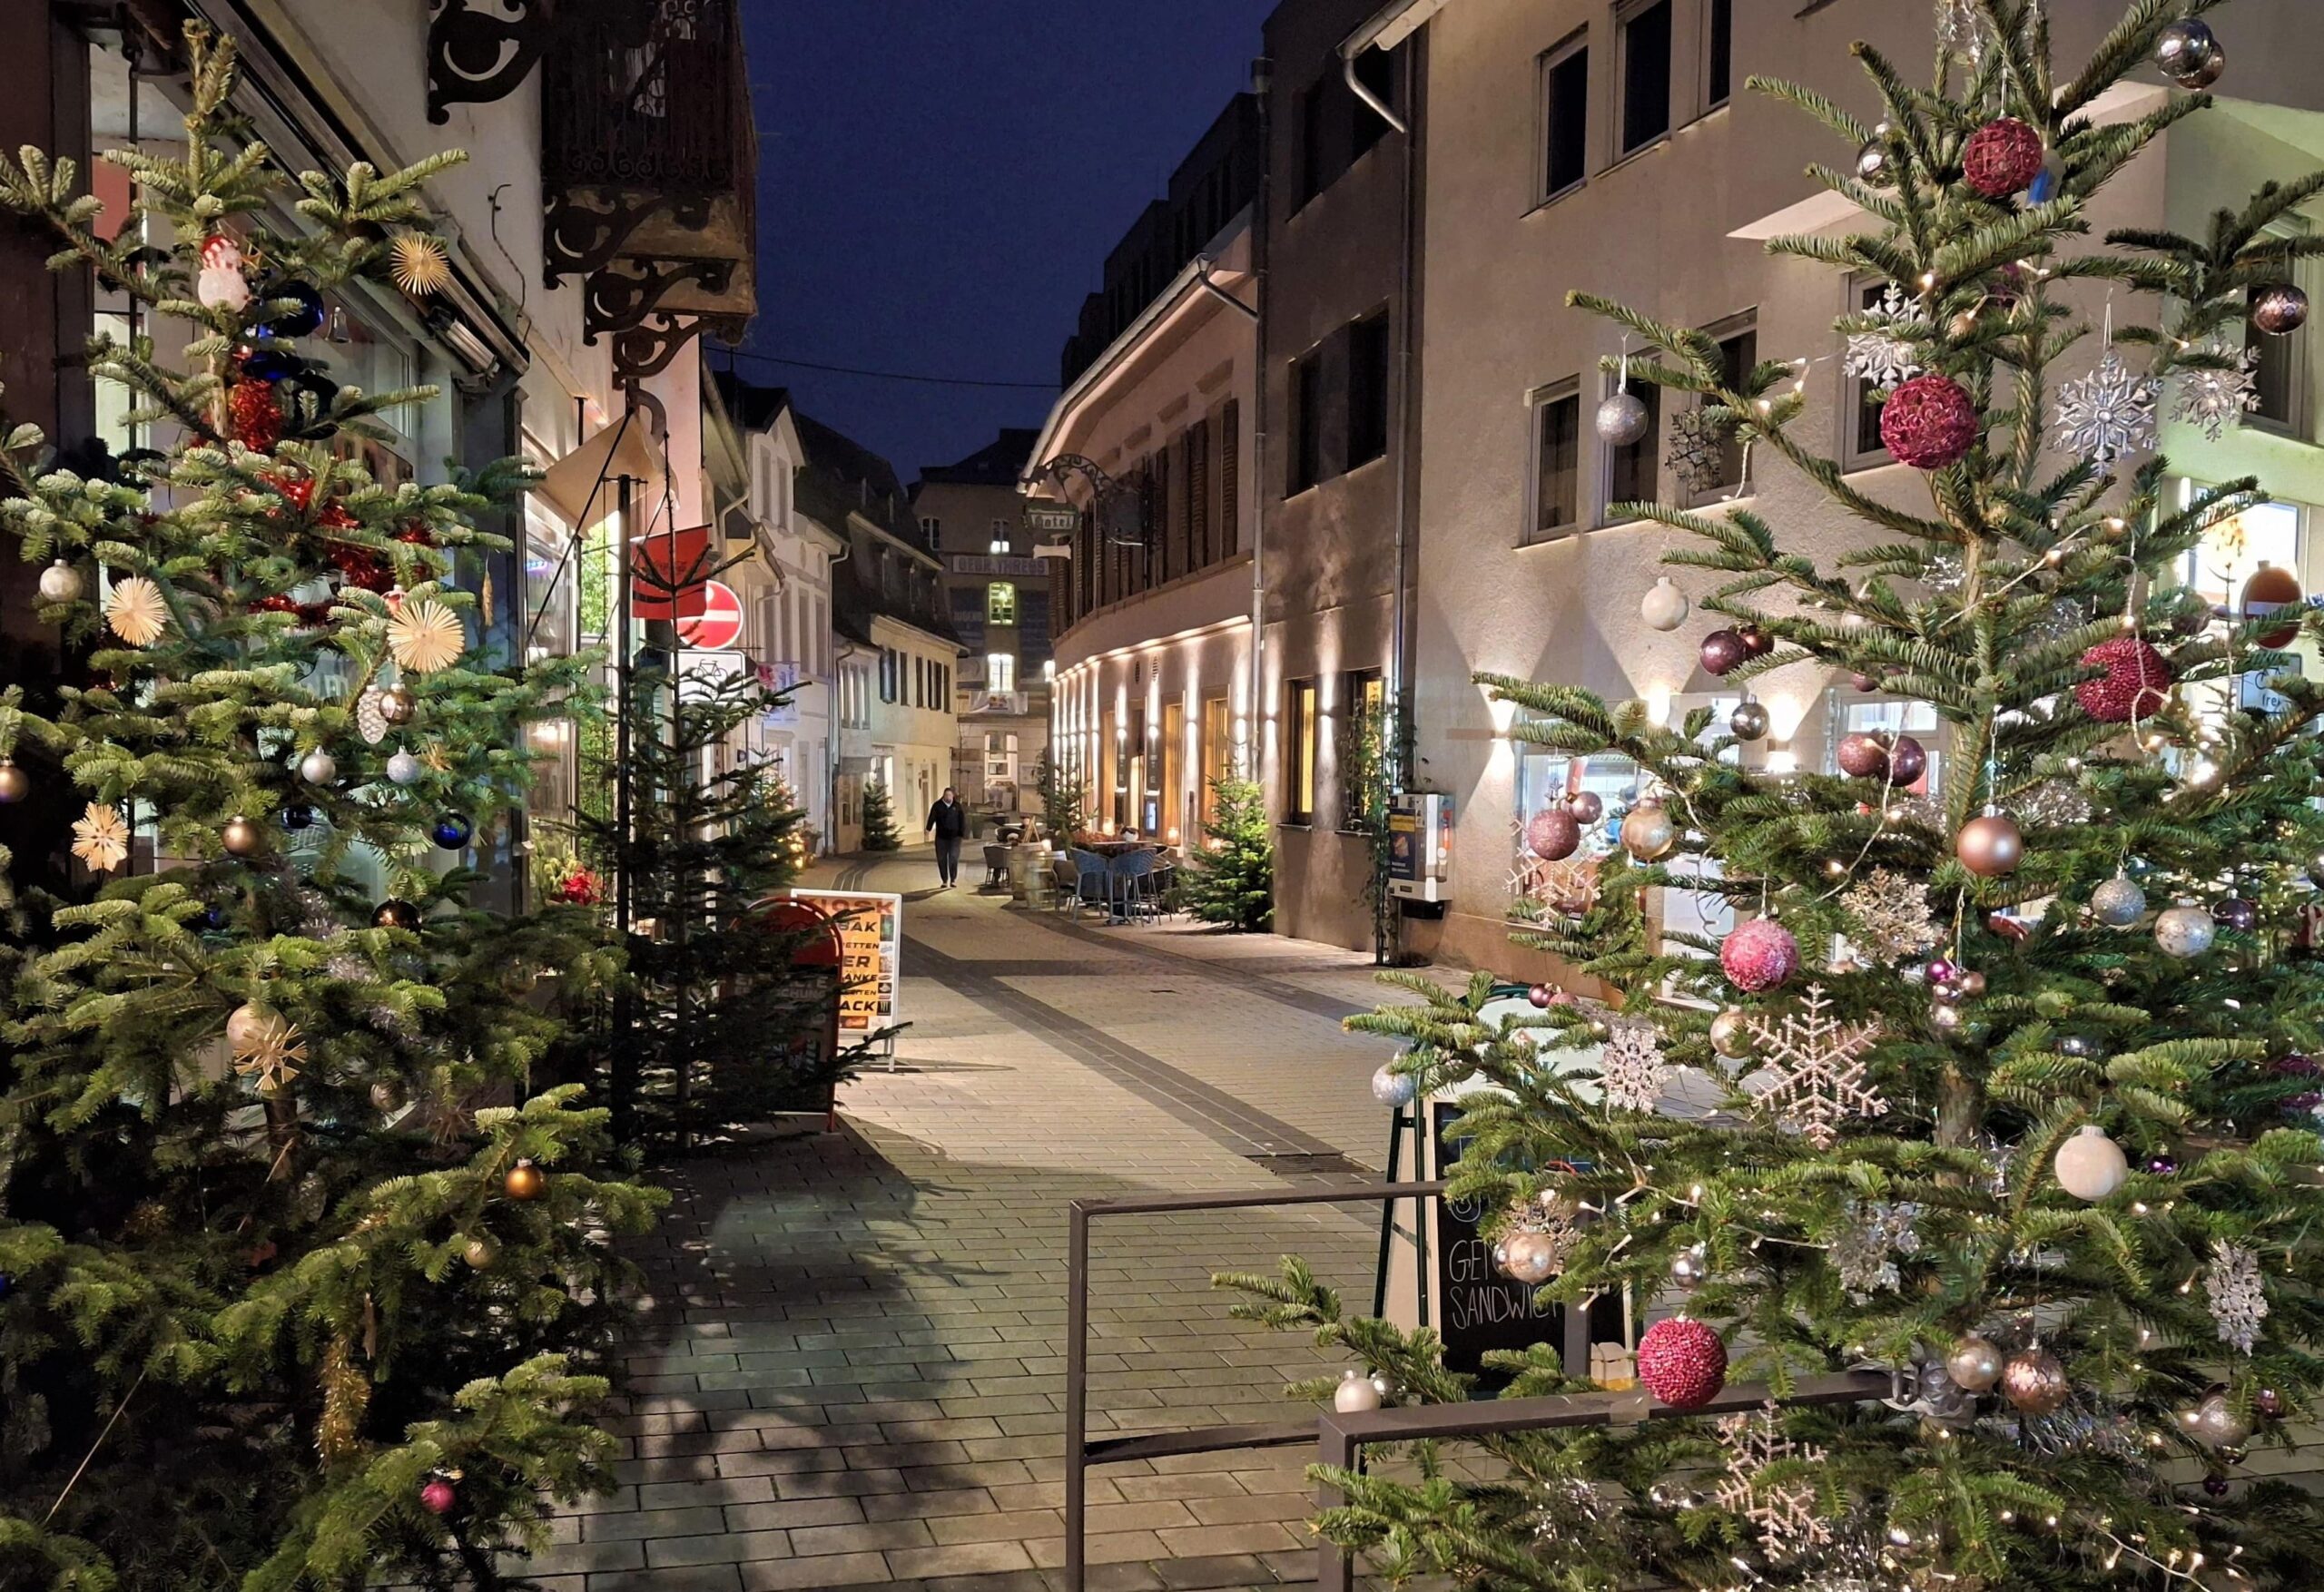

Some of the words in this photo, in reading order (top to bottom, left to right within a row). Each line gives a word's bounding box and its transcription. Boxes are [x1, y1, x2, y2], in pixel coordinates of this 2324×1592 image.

[807, 899, 894, 914] IOSK
[838, 920, 878, 932] BAK
[842, 955, 871, 968] ER
[840, 1000, 877, 1011] ACK
